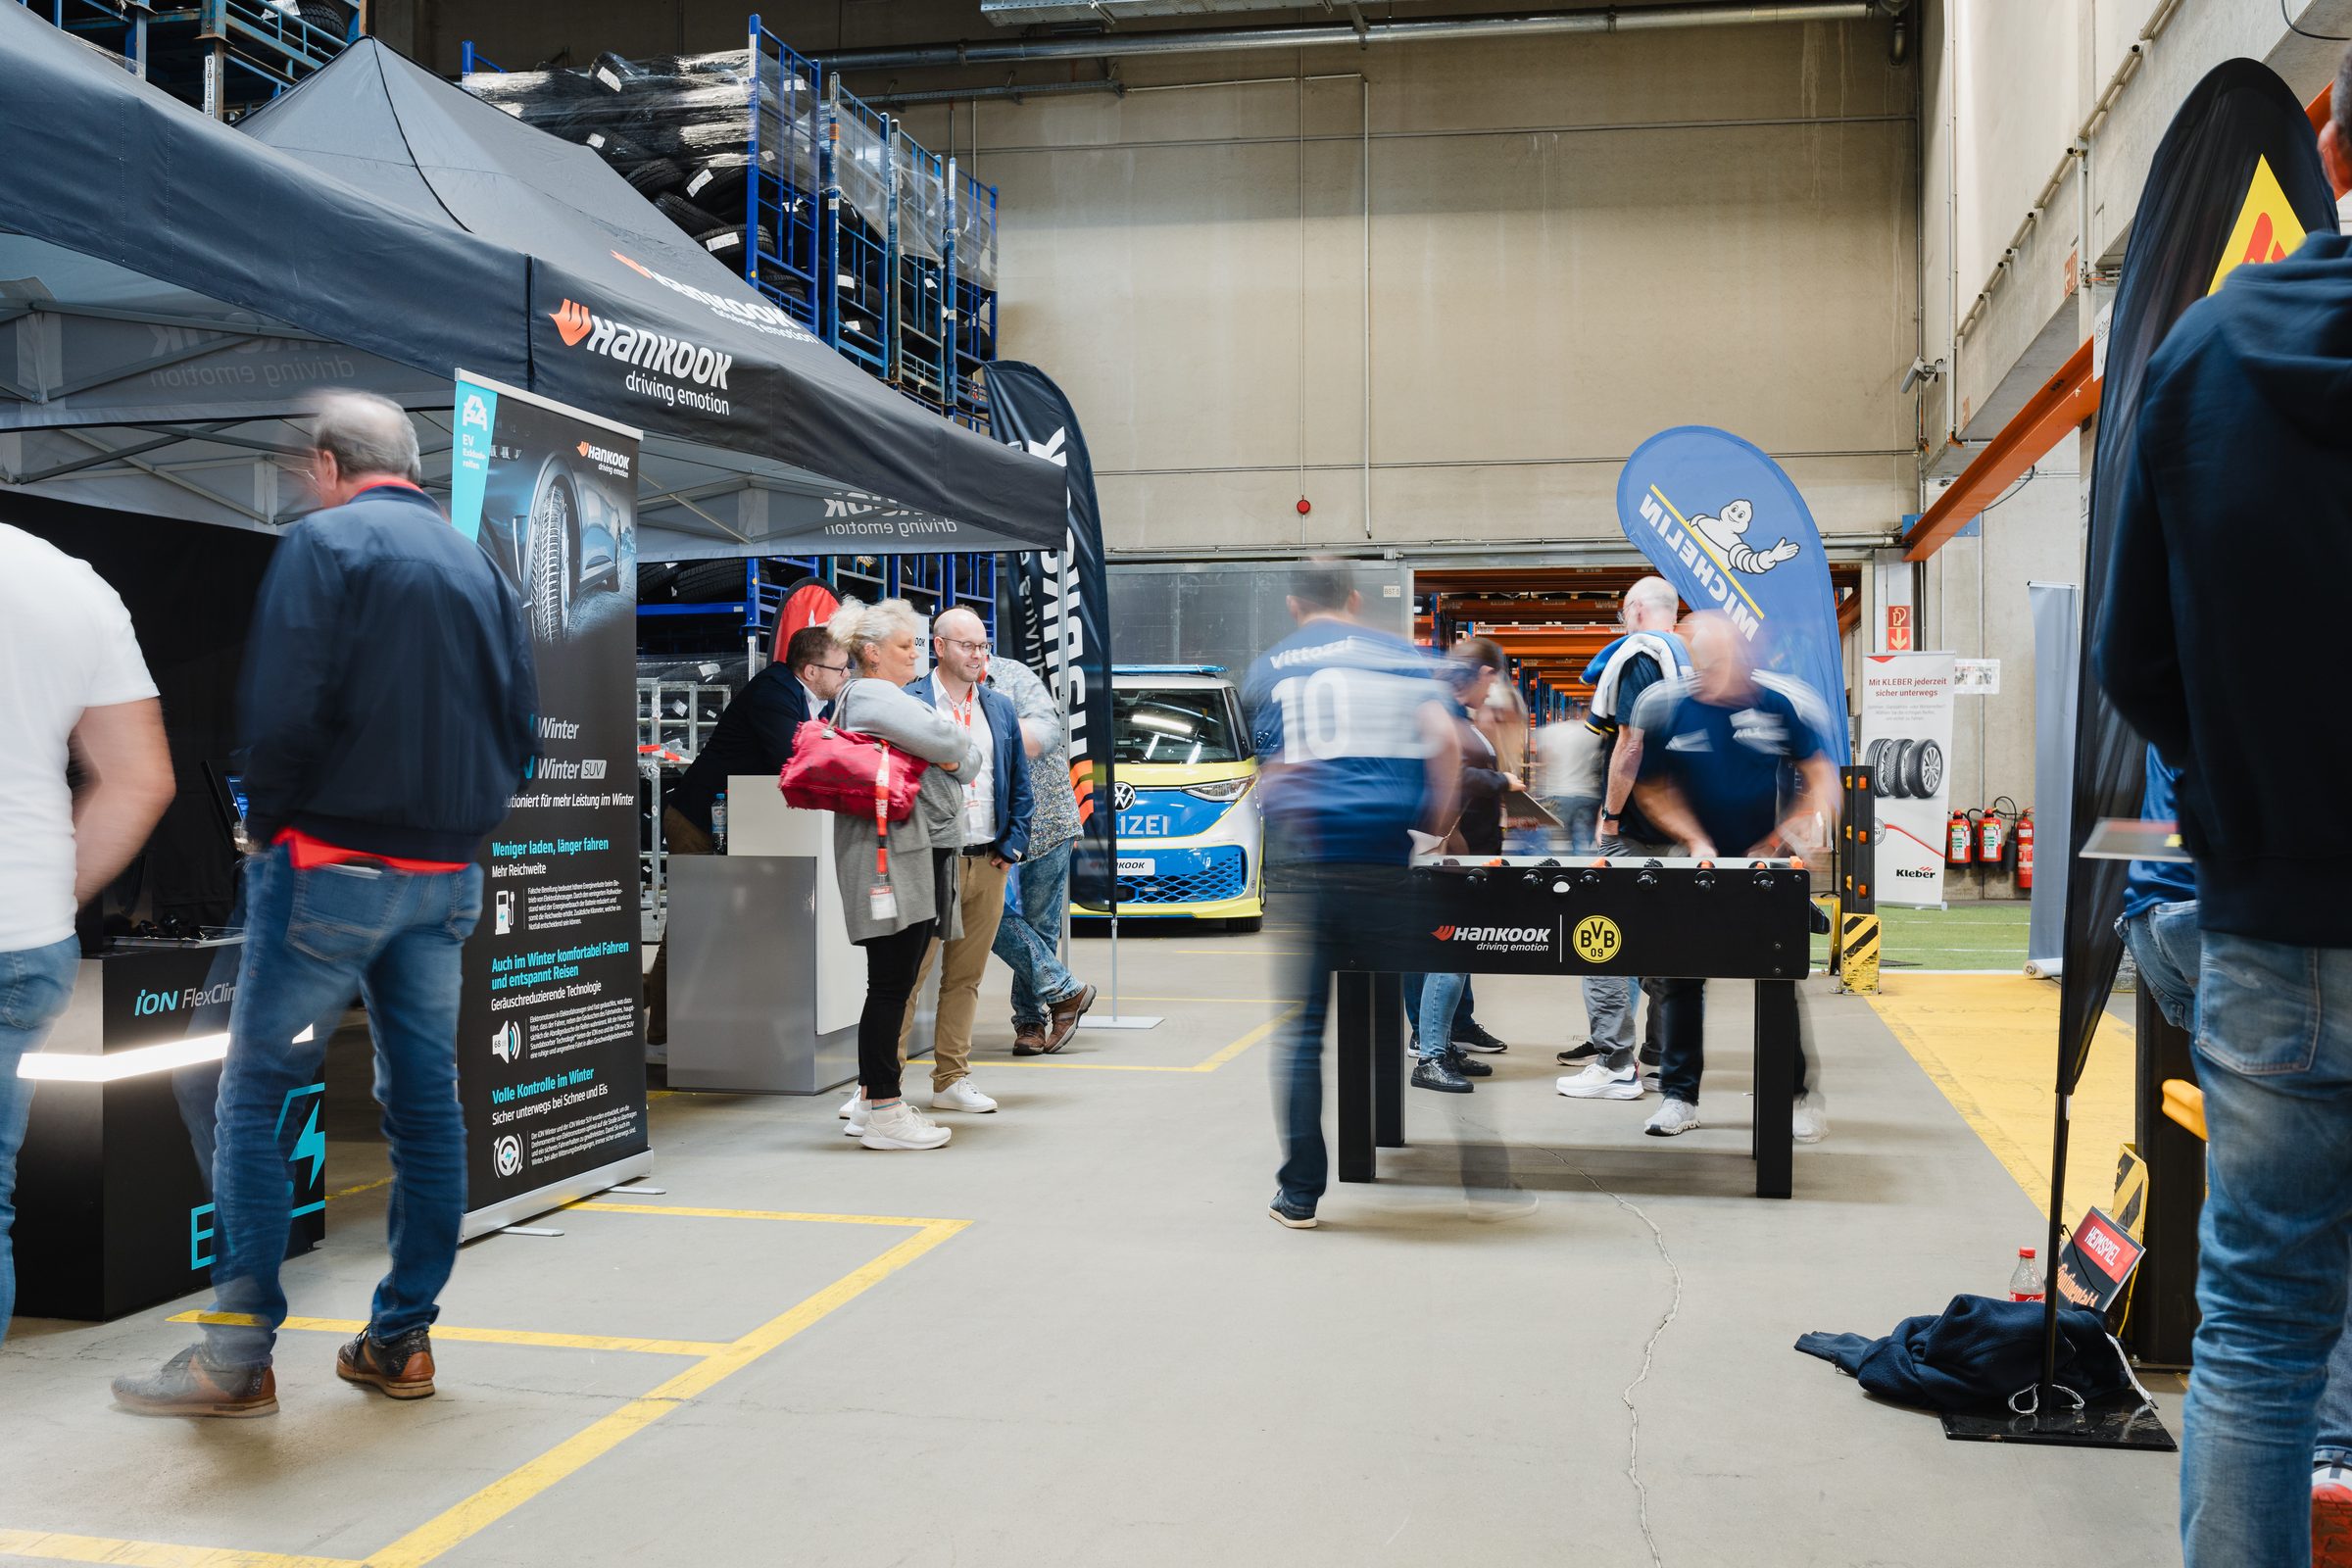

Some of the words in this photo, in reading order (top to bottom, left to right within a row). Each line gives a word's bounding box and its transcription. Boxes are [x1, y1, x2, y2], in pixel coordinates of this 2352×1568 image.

[626, 370, 674, 407] driving
[677, 387, 730, 416] emotion
[463, 433, 474, 446] EV
[598, 463, 613, 475] driving
[1914, 677, 1947, 687] jederzeit
[1899, 689, 1938, 698] unterwegs
[1271, 666, 1349, 764] 10
[537, 717, 579, 739] Winter
[538, 759, 580, 780] Winter
[583, 761, 603, 777] SUV
[541, 793, 552, 808] für
[553, 794, 571, 808] mehr
[571, 793, 600, 809] Leistung
[601, 793, 611, 807] im
[612, 792, 634, 807] Winter
[1116, 815, 1168, 835] IZEI
[492, 842, 527, 858] Weniger
[529, 840, 556, 856] laden,
[558, 839, 582, 856] länger
[583, 837, 609, 851] fahren
[492, 864, 508, 878] Mehr
[509, 861, 547, 876] Reichweite
[1896, 869, 1936, 878] Kleber
[1581, 921, 1616, 948] BVB
[492, 956, 513, 973] Auch
[514, 955, 526, 969] im
[527, 951, 556, 966] Winter
[557, 944, 602, 963] komfortabel
[602, 941, 629, 955] Fahren
[1476, 942, 1507, 953] driving
[1510, 943, 1548, 952] emotion
[1591, 948, 1604, 957] 09
[492, 975, 507, 990] und
[509, 968, 552, 988] entspannt
[553, 964, 578, 979] Reisen
[134, 989, 178, 1016] iON
[491, 987, 565, 1011] Geräuschreduzierende
[566, 980, 602, 997] Technologie
[492, 1089, 514, 1104] Volle
[516, 1077, 555, 1099] Kontrolle
[557, 1074, 567, 1088] im
[569, 1067, 595, 1085] Winter
[492, 1111, 514, 1126] Sicher
[515, 1101, 552, 1119] unterwegs
[552, 1096, 564, 1109] bei
[564, 1091, 586, 1106] Schnee
[586, 1086, 598, 1101] und
[599, 1083, 609, 1096] Eis
[2083, 1225, 2121, 1266] HEIMSPIEL
